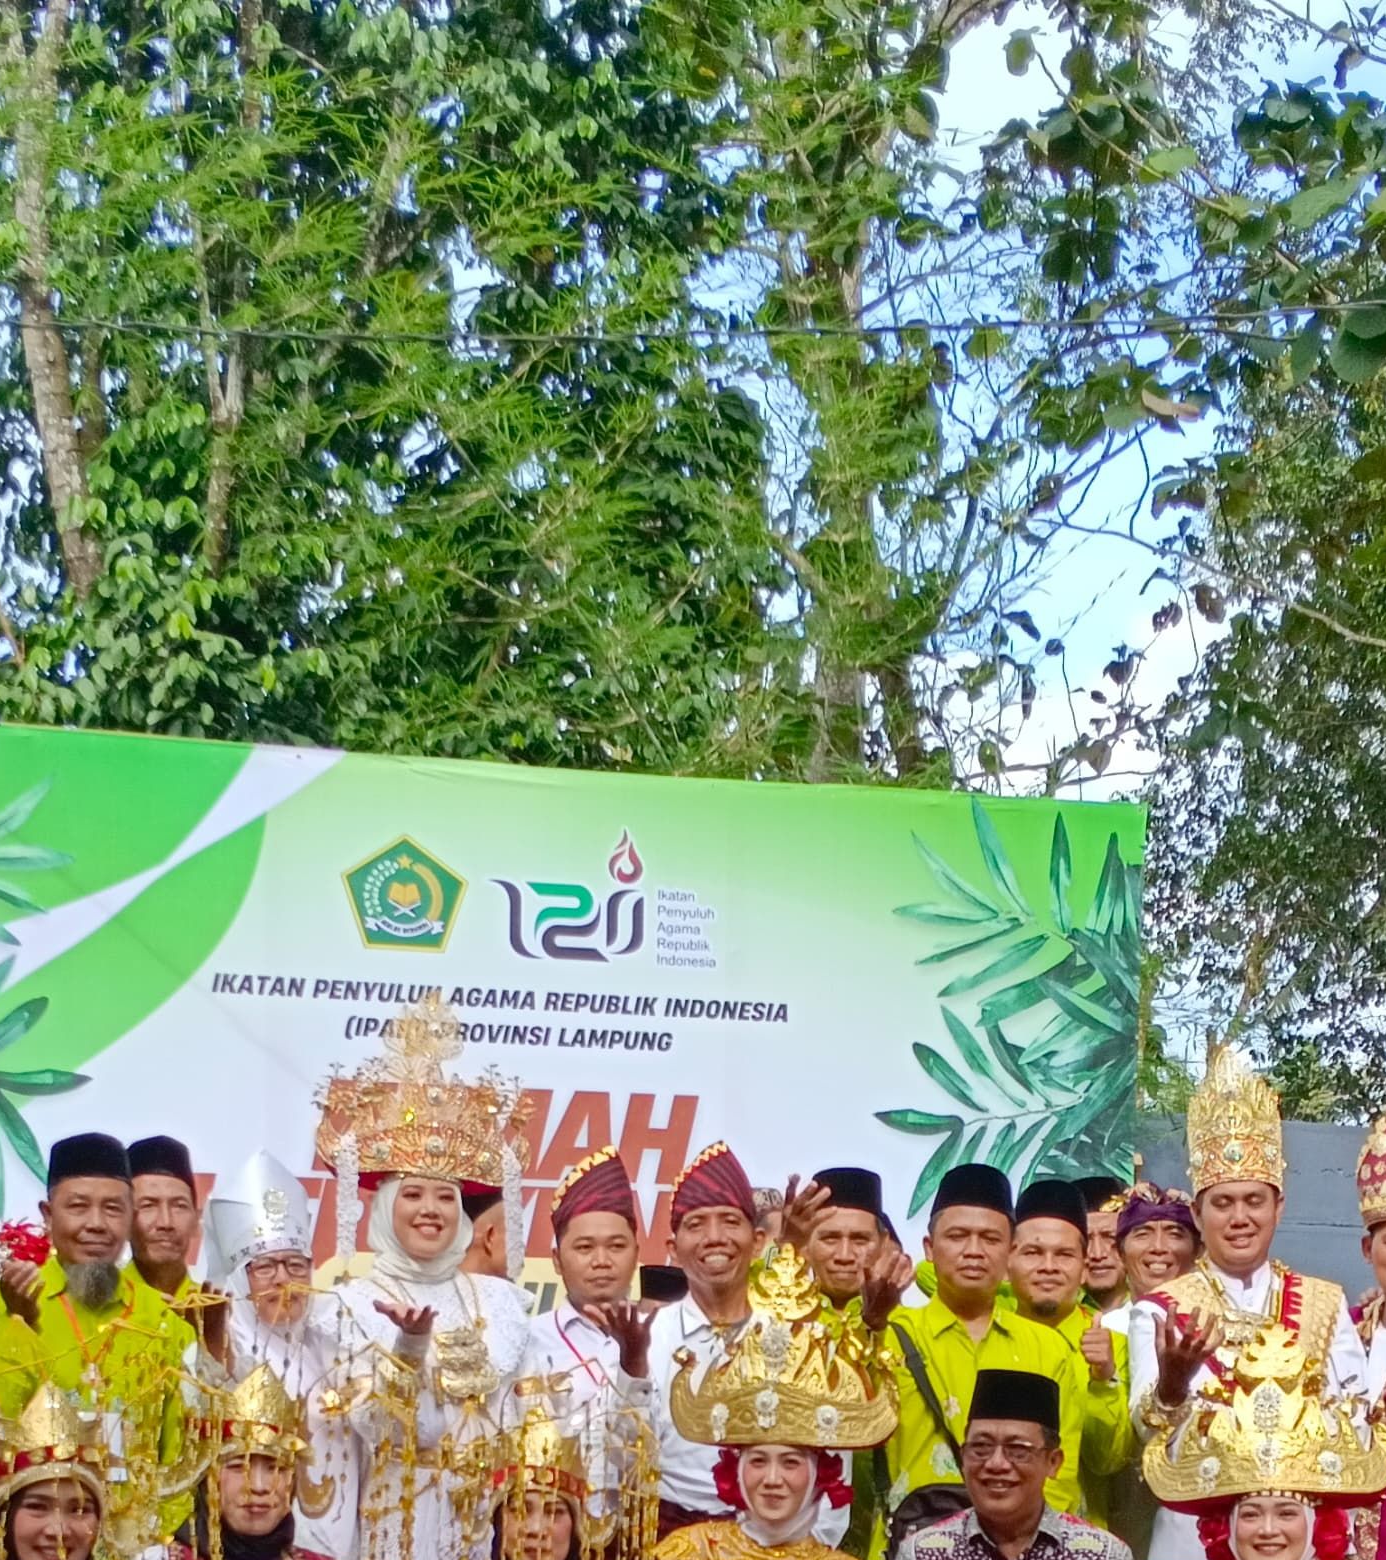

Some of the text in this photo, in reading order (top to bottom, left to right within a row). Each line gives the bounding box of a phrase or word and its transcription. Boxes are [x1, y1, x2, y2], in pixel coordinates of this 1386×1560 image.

[657, 889, 695, 902] Ikatan
[657, 904, 715, 921] Penyuluh
[657, 921, 701, 937] Agama
[656, 938, 710, 953] Republik
[656, 955, 717, 969] Indonesia
[211, 972, 306, 998] IKATAN
[449, 986, 537, 1011] AGAMA
[544, 991, 659, 1017] REPUBLIK
[663, 997, 789, 1023] INDONESIA
[557, 1027, 674, 1052] LAMPUNG
